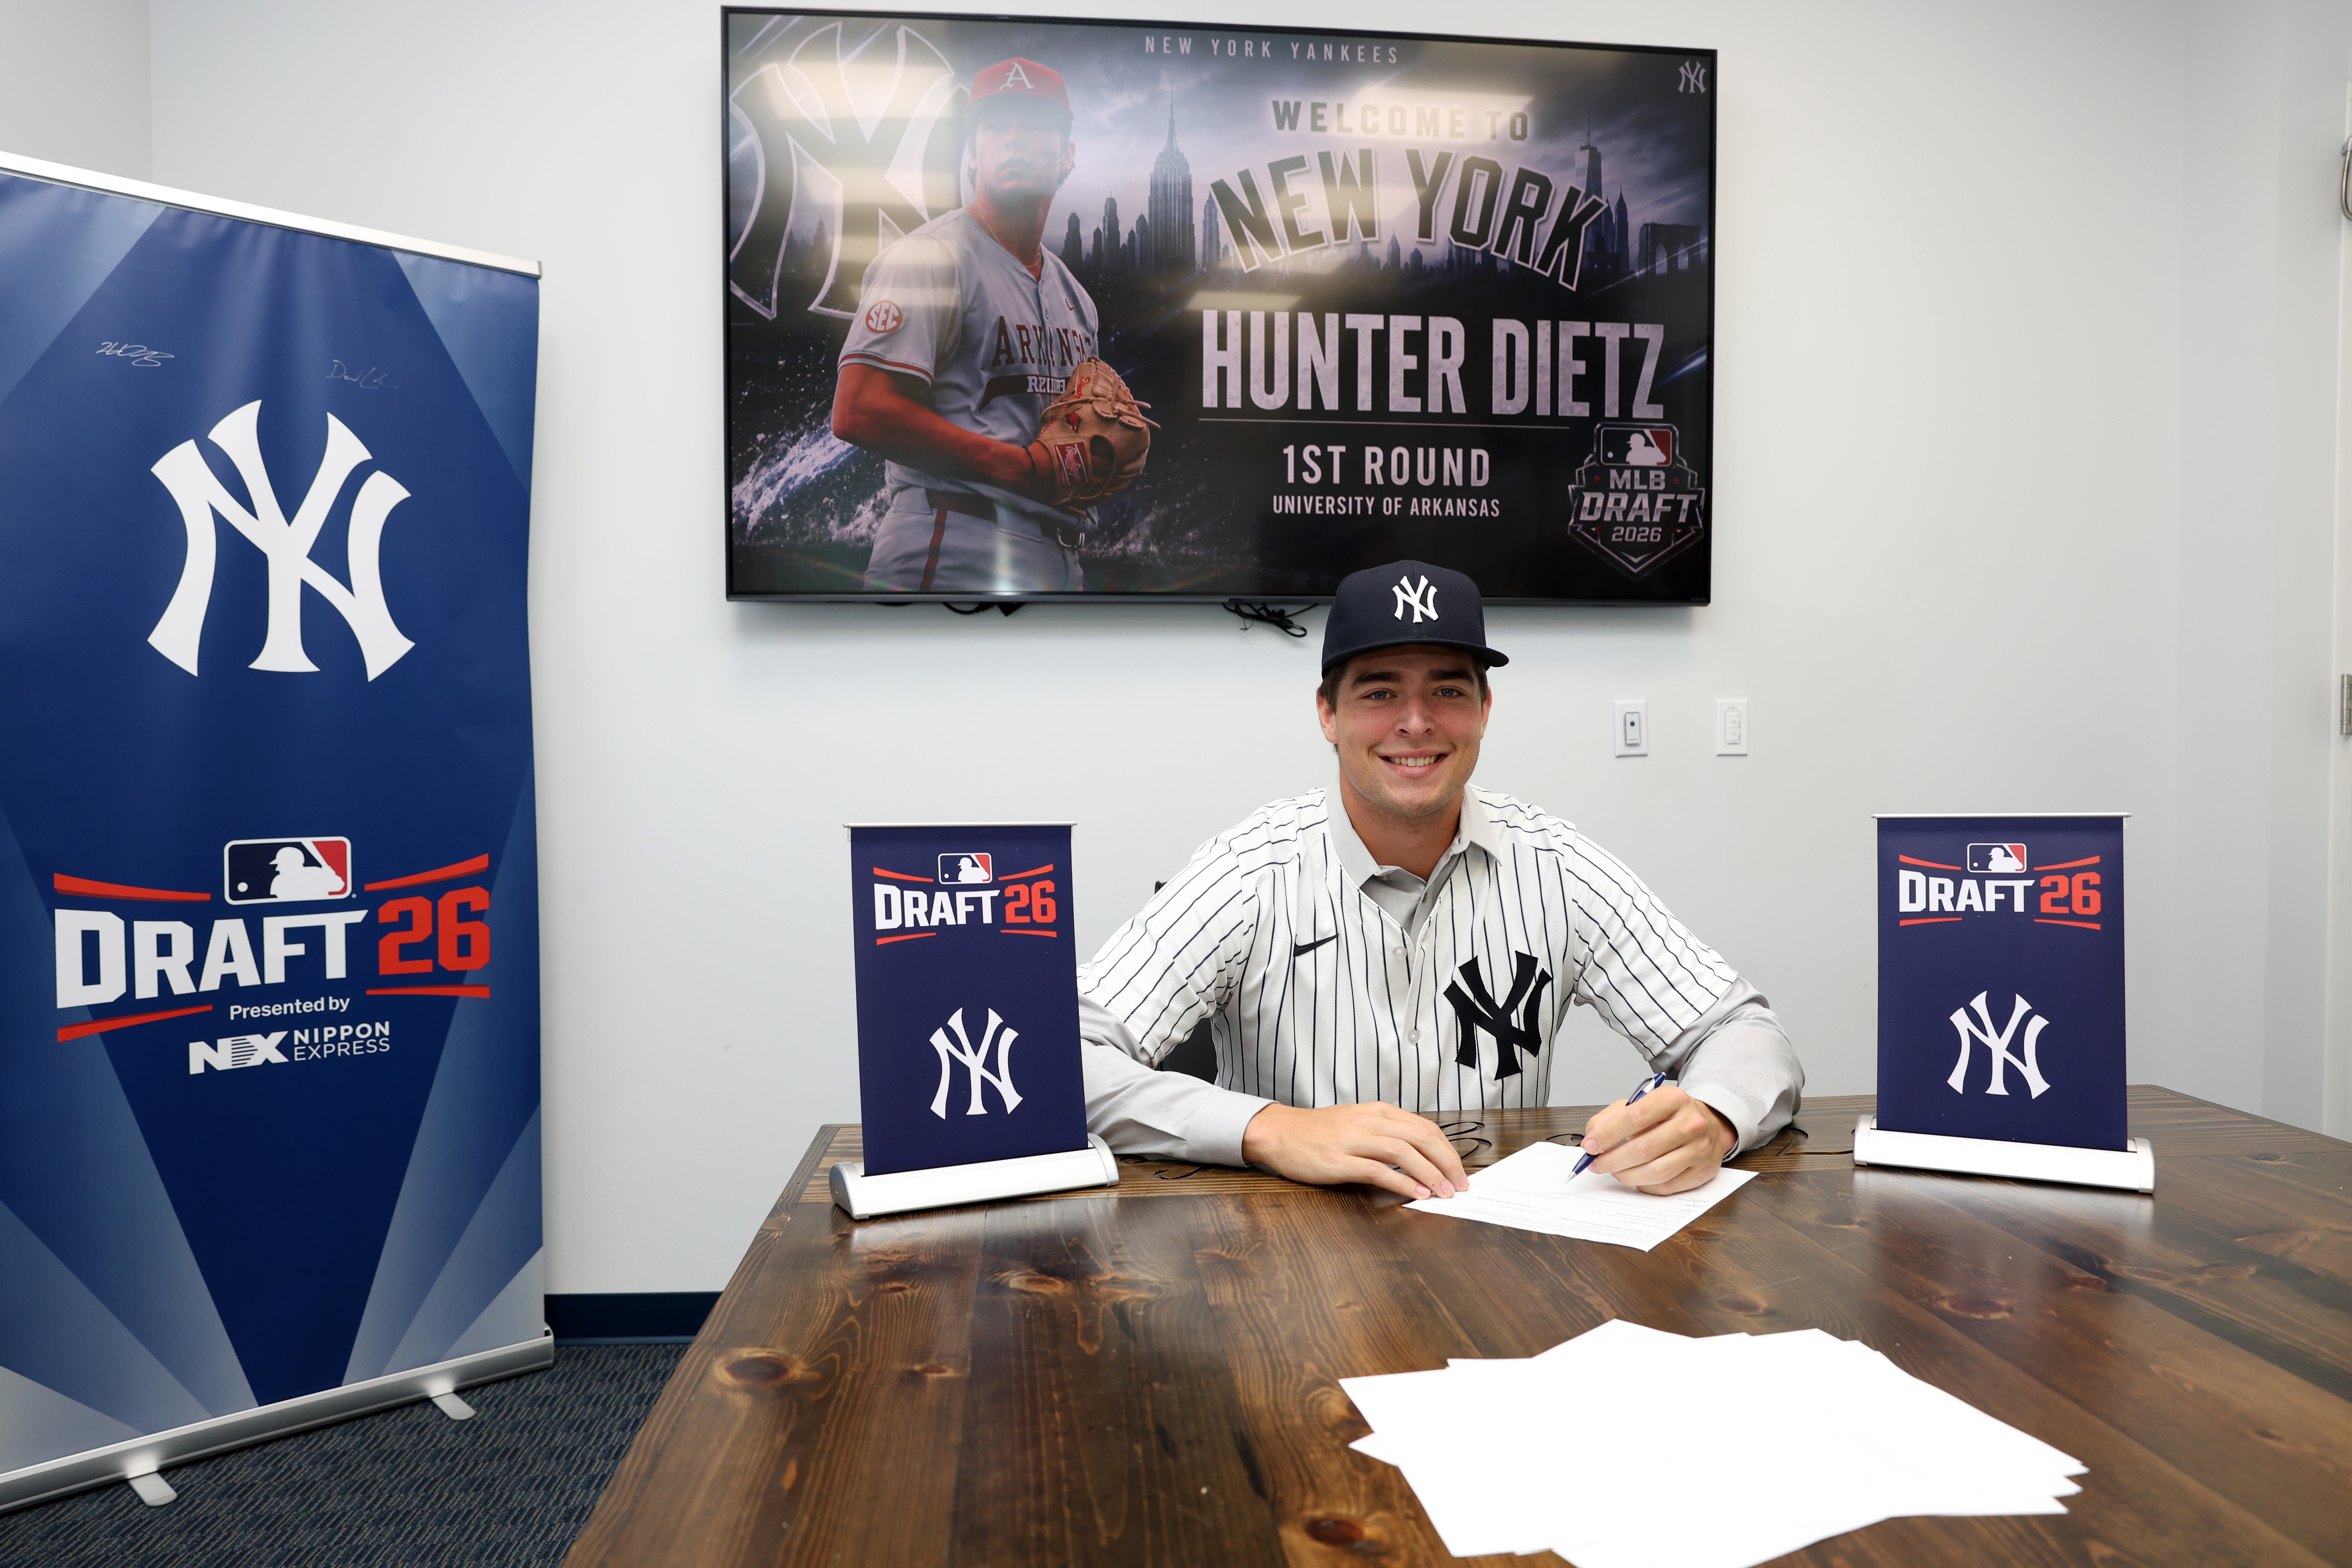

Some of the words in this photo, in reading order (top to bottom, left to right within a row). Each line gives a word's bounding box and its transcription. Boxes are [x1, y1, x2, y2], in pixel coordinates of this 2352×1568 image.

[1145, 36, 1192, 54] NEW
[1211, 39, 1271, 57] YORK
[1291, 42, 1397, 64] YANKEES
[1678, 60, 1707, 94] NY
[1272, 100, 1465, 138] WELCOME
[1485, 110, 1528, 141] TO
[1209, 147, 1380, 274] NEW
[1403, 147, 1609, 292] YORK
[867, 302, 900, 331] SEC
[1202, 309, 1467, 414] HUNTER
[1492, 318, 1664, 419] DIETZ
[1283, 444, 1346, 485] 1ST
[1365, 446, 1490, 488] ROUND
[1609, 468, 1666, 490] MLB
[1272, 495, 1375, 515] UNIVERSITY
[1383, 496, 1403, 515] OF
[1410, 497, 1500, 517] ARKANSAS
[1579, 492, 1698, 523] DRAFT
[147, 399, 416, 683] NY
[1611, 526, 1662, 543] 2026
[1392, 575, 1439, 623] NY
[874, 883, 1000, 930] DRAFT
[1004, 880, 1057, 924] 26
[1899, 869, 2035, 913] DRAFT
[2040, 871, 2102, 915] 26
[54, 908, 368, 1009] DRAFT
[377, 886, 490, 975] 26
[230, 996, 325, 1020] Presented
[328, 996, 350, 1013] by
[1443, 950, 1553, 1081] NY
[294, 1021, 390, 1045] NIPPON
[294, 1037, 390, 1061] EXPRESS
[1946, 990, 2051, 1100] NY
[929, 1007, 1024, 1120] NY
